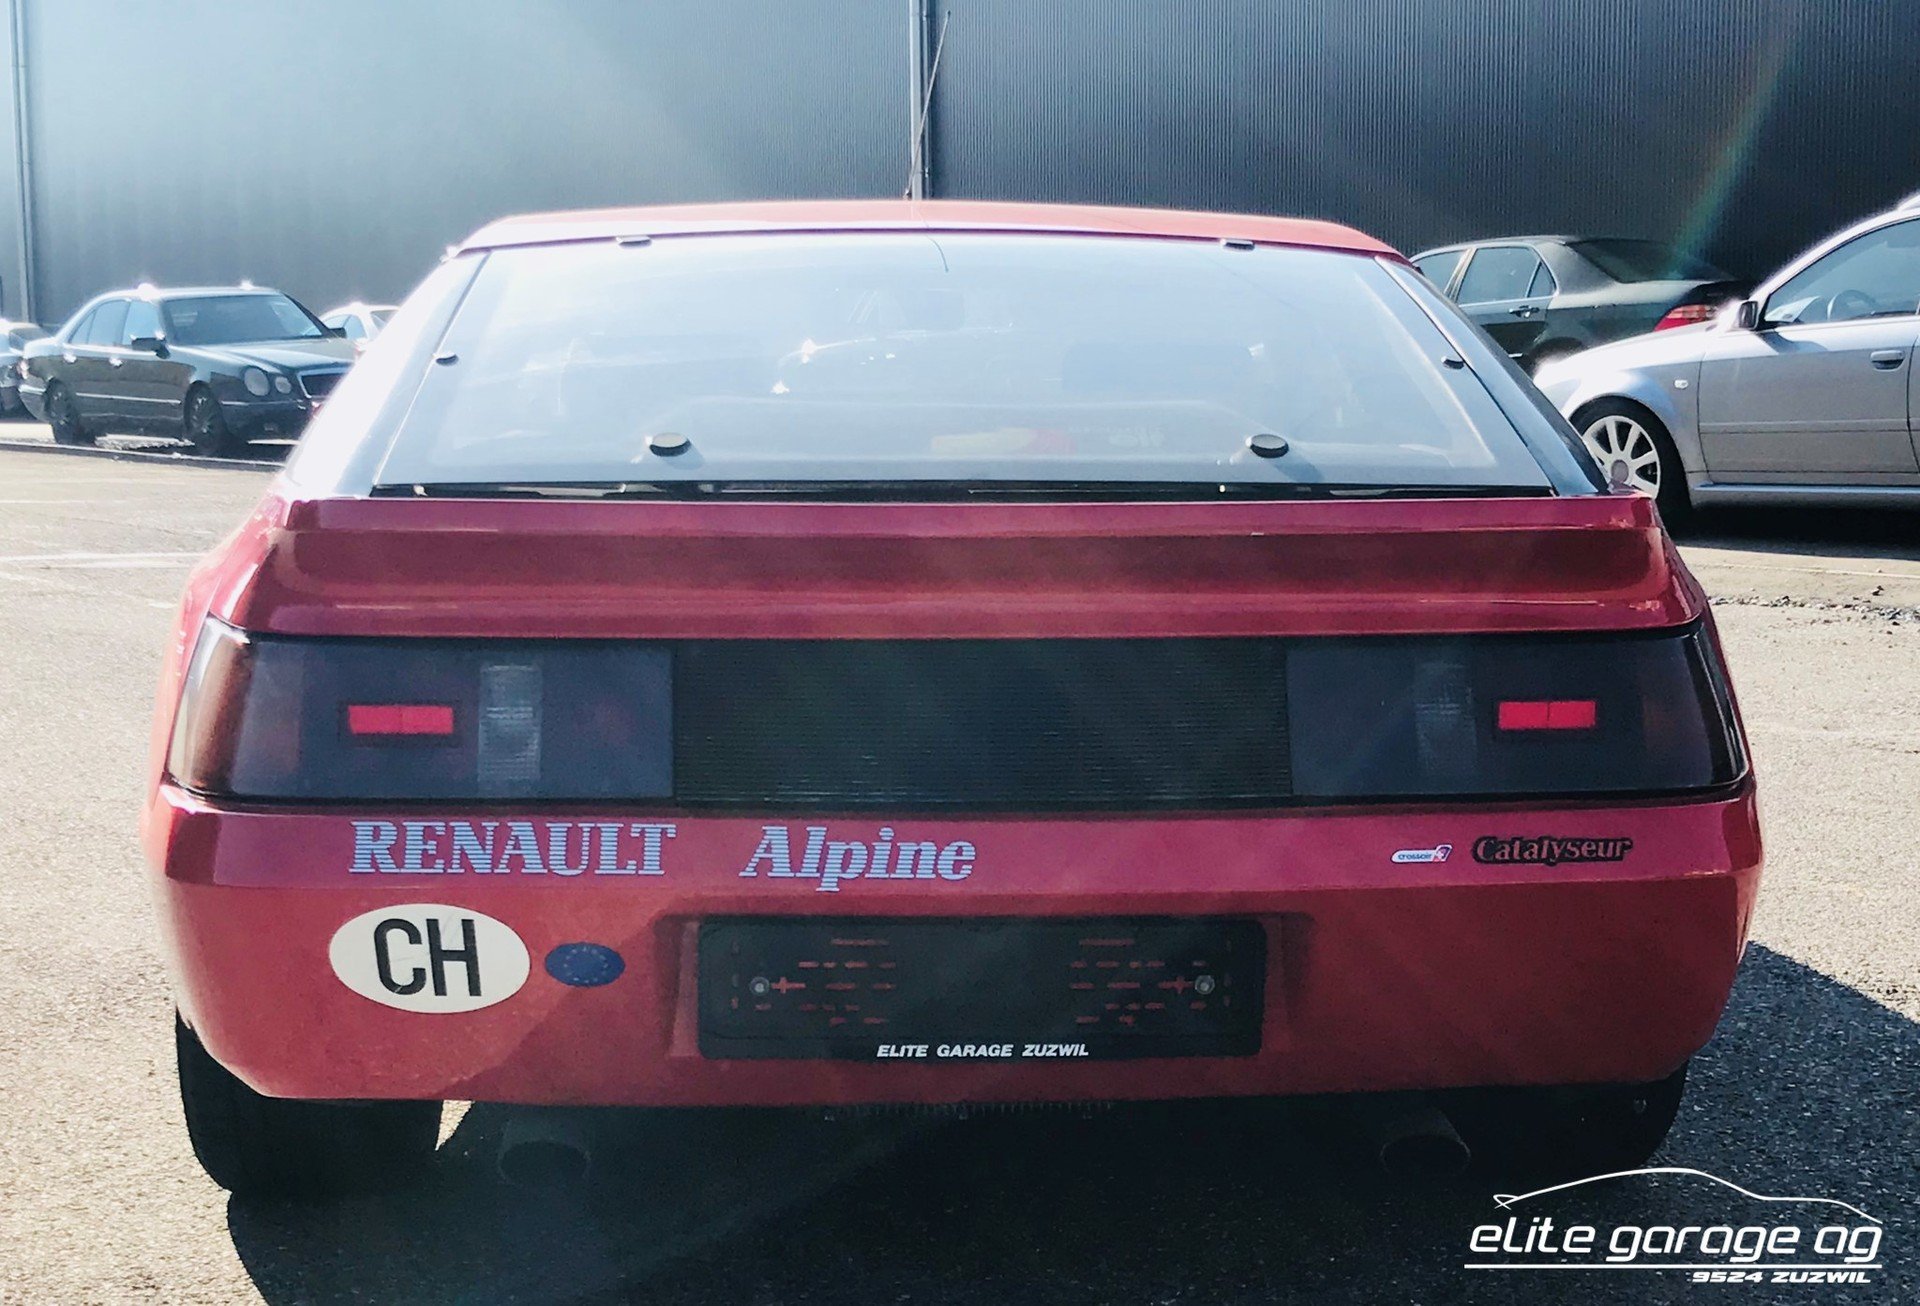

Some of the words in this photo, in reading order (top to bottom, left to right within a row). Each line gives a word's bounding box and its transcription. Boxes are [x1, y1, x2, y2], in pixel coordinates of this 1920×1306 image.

[347, 820, 677, 876] RENAULT
[738, 825, 976, 891] Alpine
[1474, 836, 1632, 866] Catalyseur
[373, 917, 482, 997] CH
[876, 1043, 928, 1058] ELITE
[936, 1043, 1013, 1058] GARAGE
[1021, 1042, 1090, 1058] ZUZWIL
